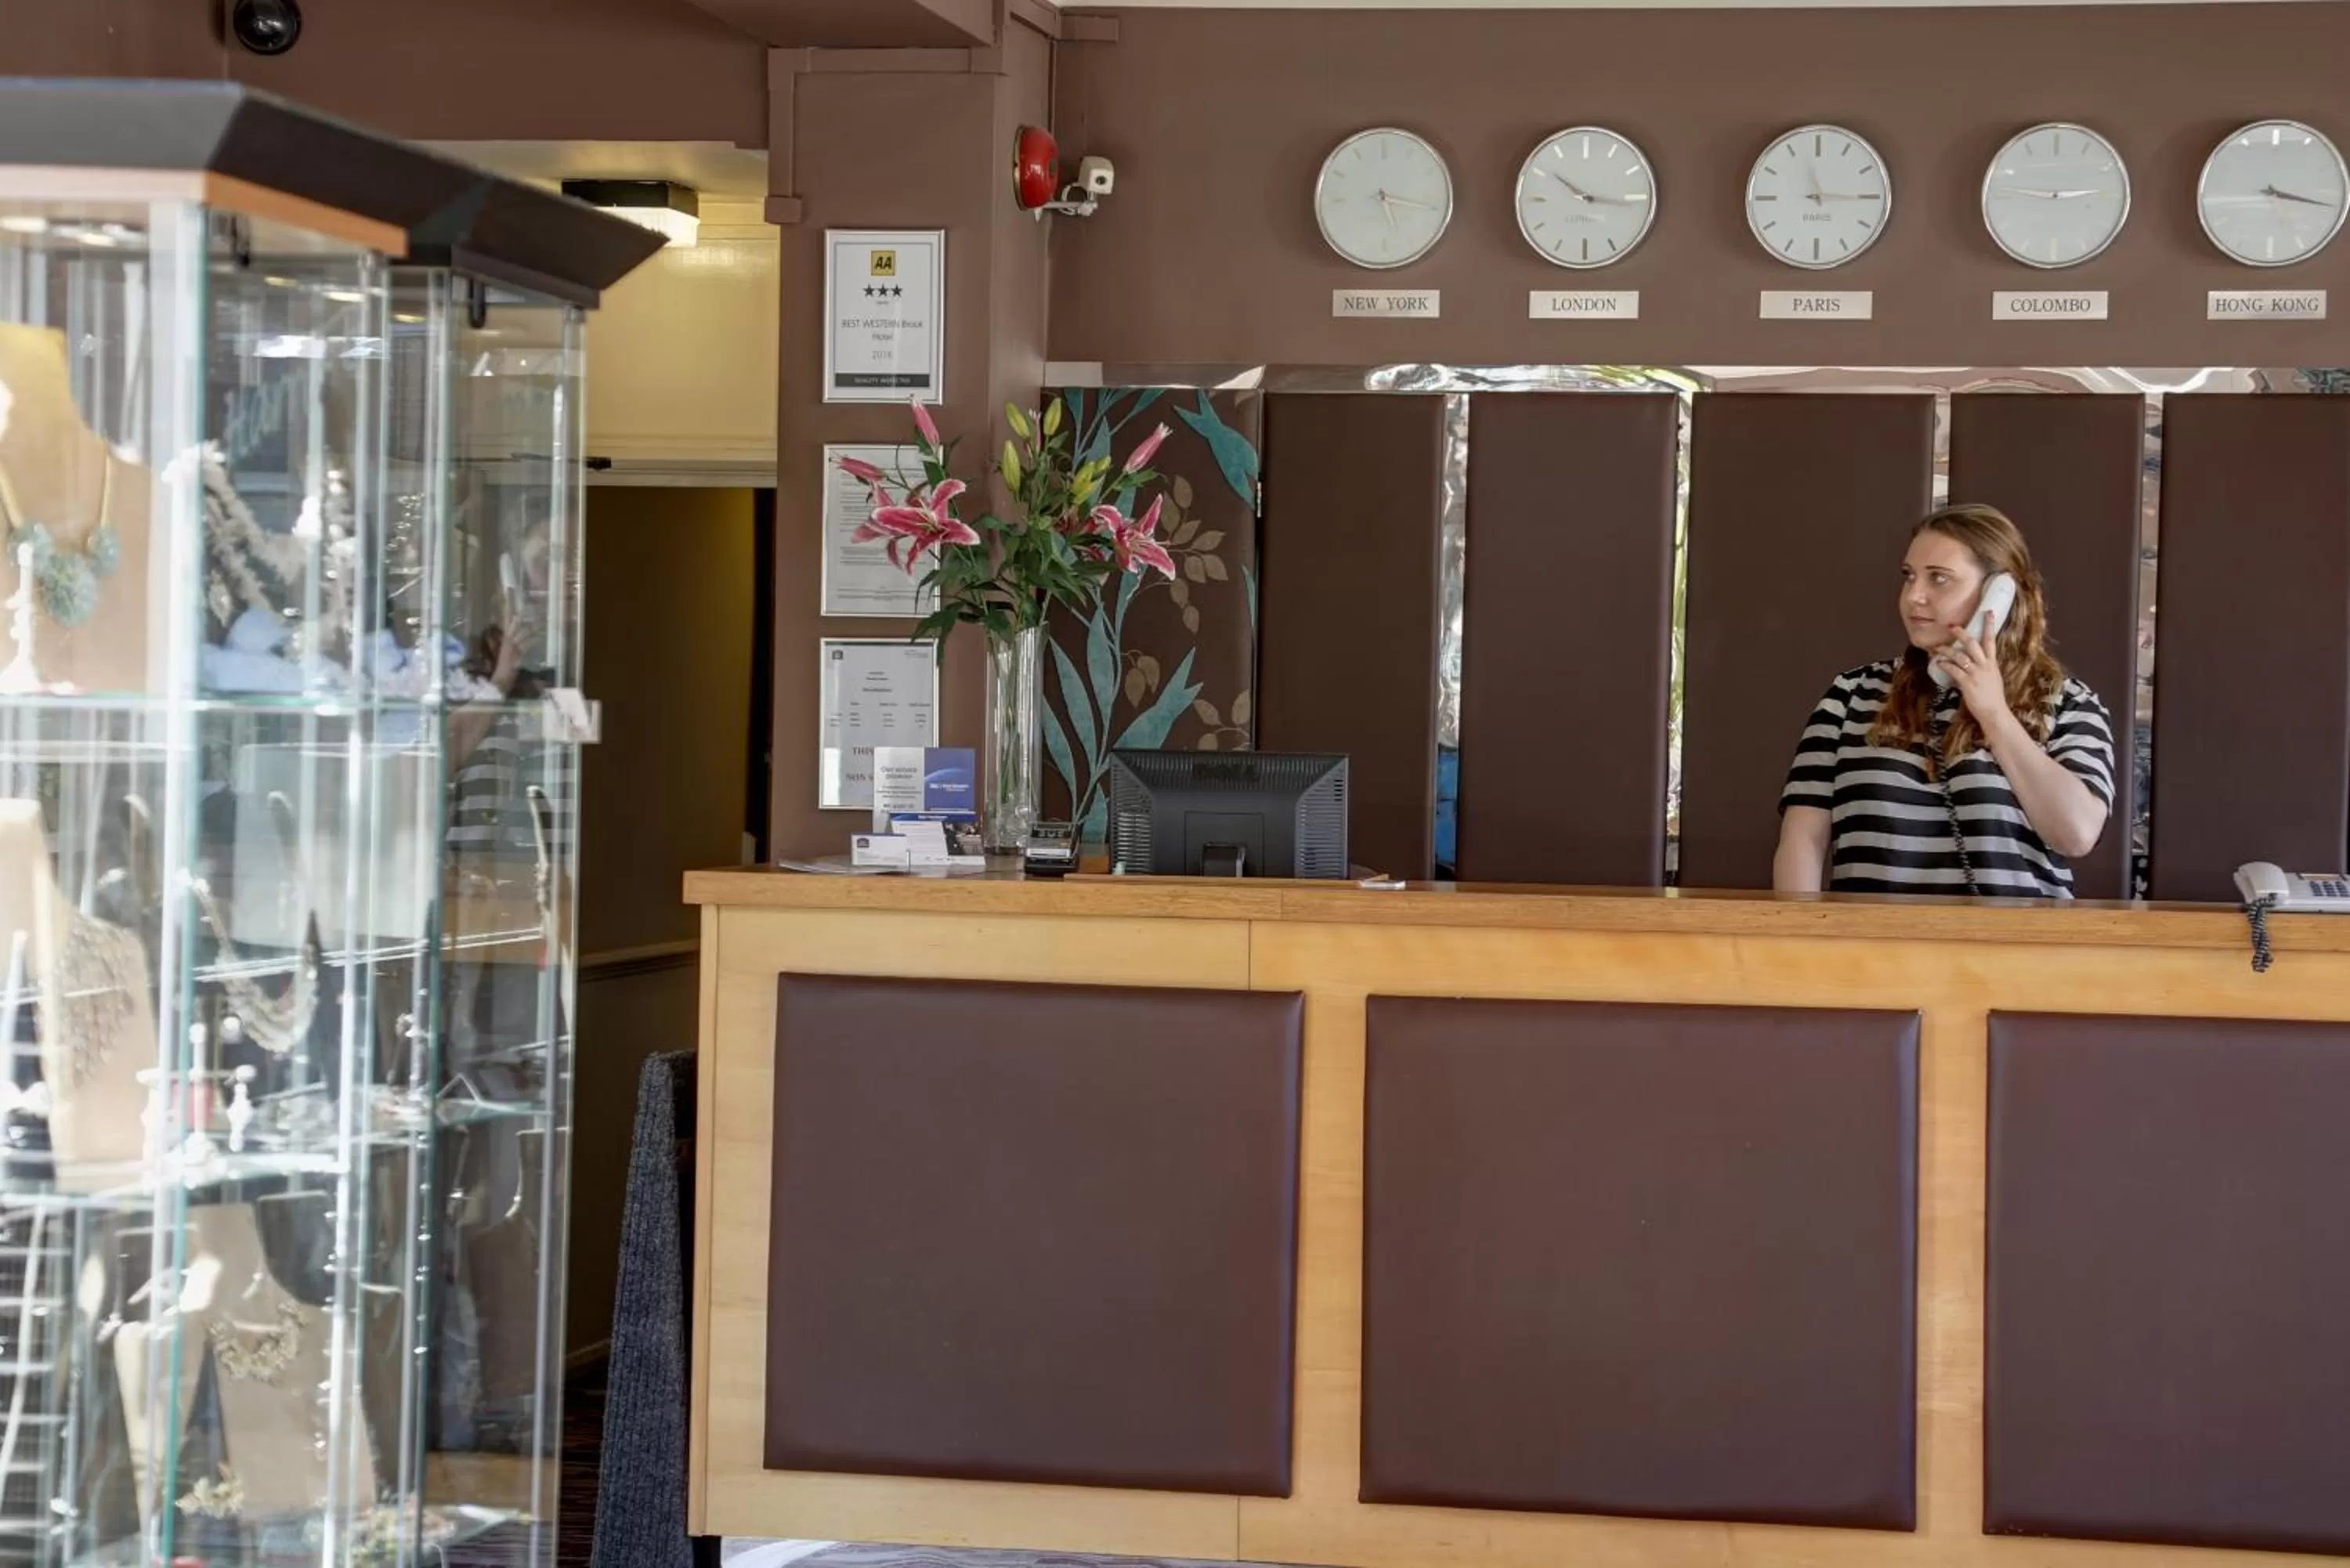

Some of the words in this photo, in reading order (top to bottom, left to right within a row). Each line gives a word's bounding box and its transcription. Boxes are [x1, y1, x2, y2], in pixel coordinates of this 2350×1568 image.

[873, 256, 892, 270] AA
[1343, 296, 1379, 312] NEW
[1386, 296, 1430, 312] YORK
[1551, 297, 1618, 313] LONDON
[1792, 297, 1842, 313] PARIS
[2010, 297, 2092, 313] COLOMBO
[2214, 298, 2264, 313] HONG
[2271, 298, 2320, 313] KONG
[841, 319, 859, 328] BEST
